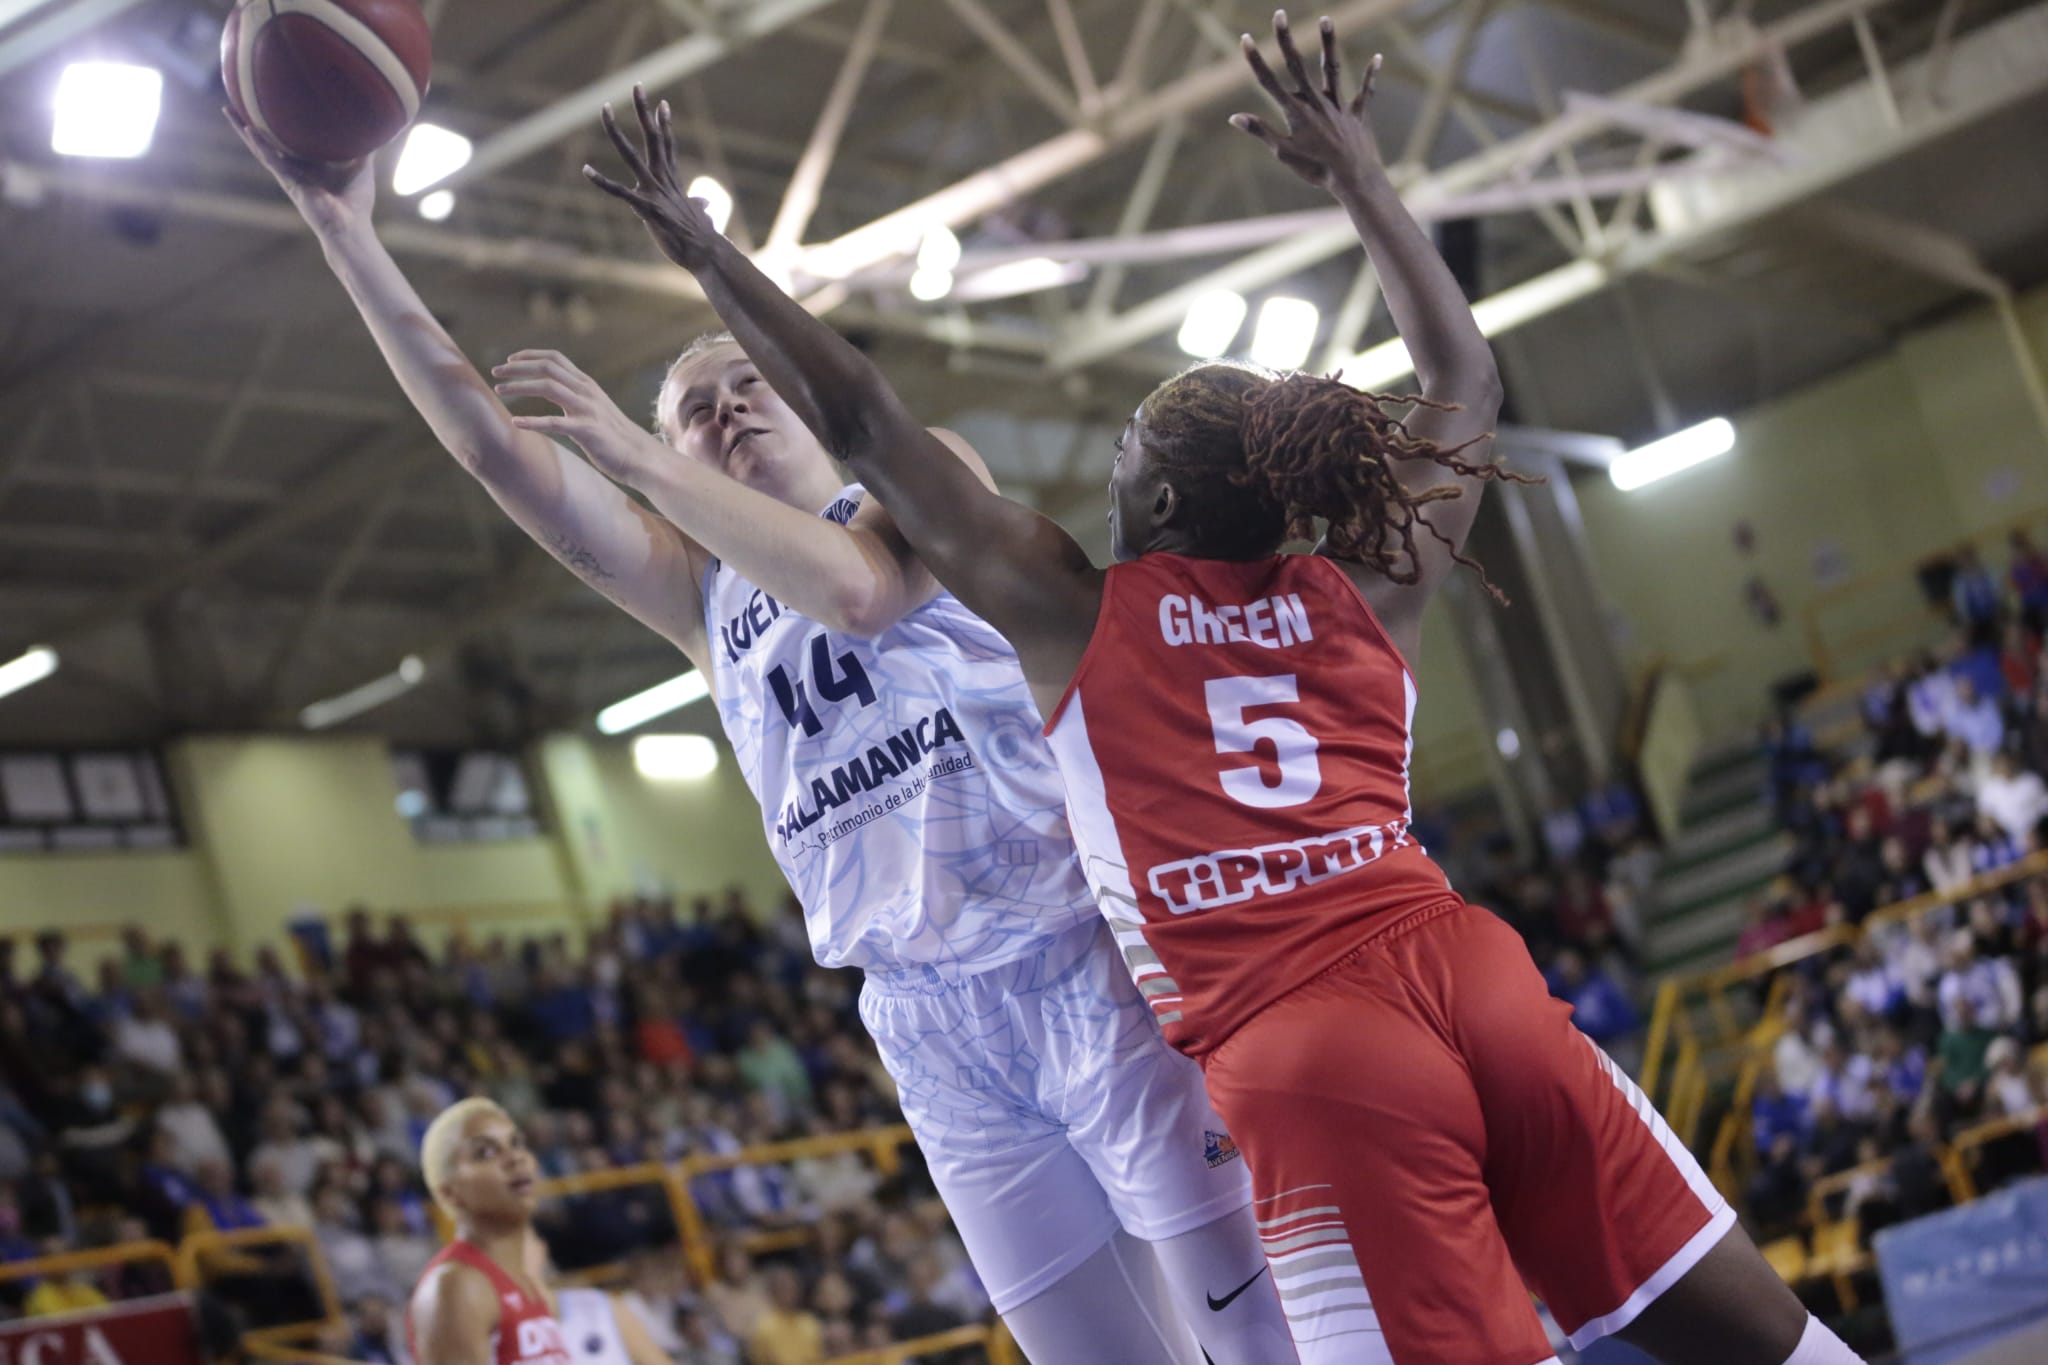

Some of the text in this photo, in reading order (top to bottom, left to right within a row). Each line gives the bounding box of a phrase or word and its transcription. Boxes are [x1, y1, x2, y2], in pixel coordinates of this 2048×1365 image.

[766, 632, 878, 738] 44
[885, 794, 901, 809] de
[900, 786, 914, 801] la
[912, 751, 973, 793] Huanidad
[1203, 673, 1322, 809] 5
